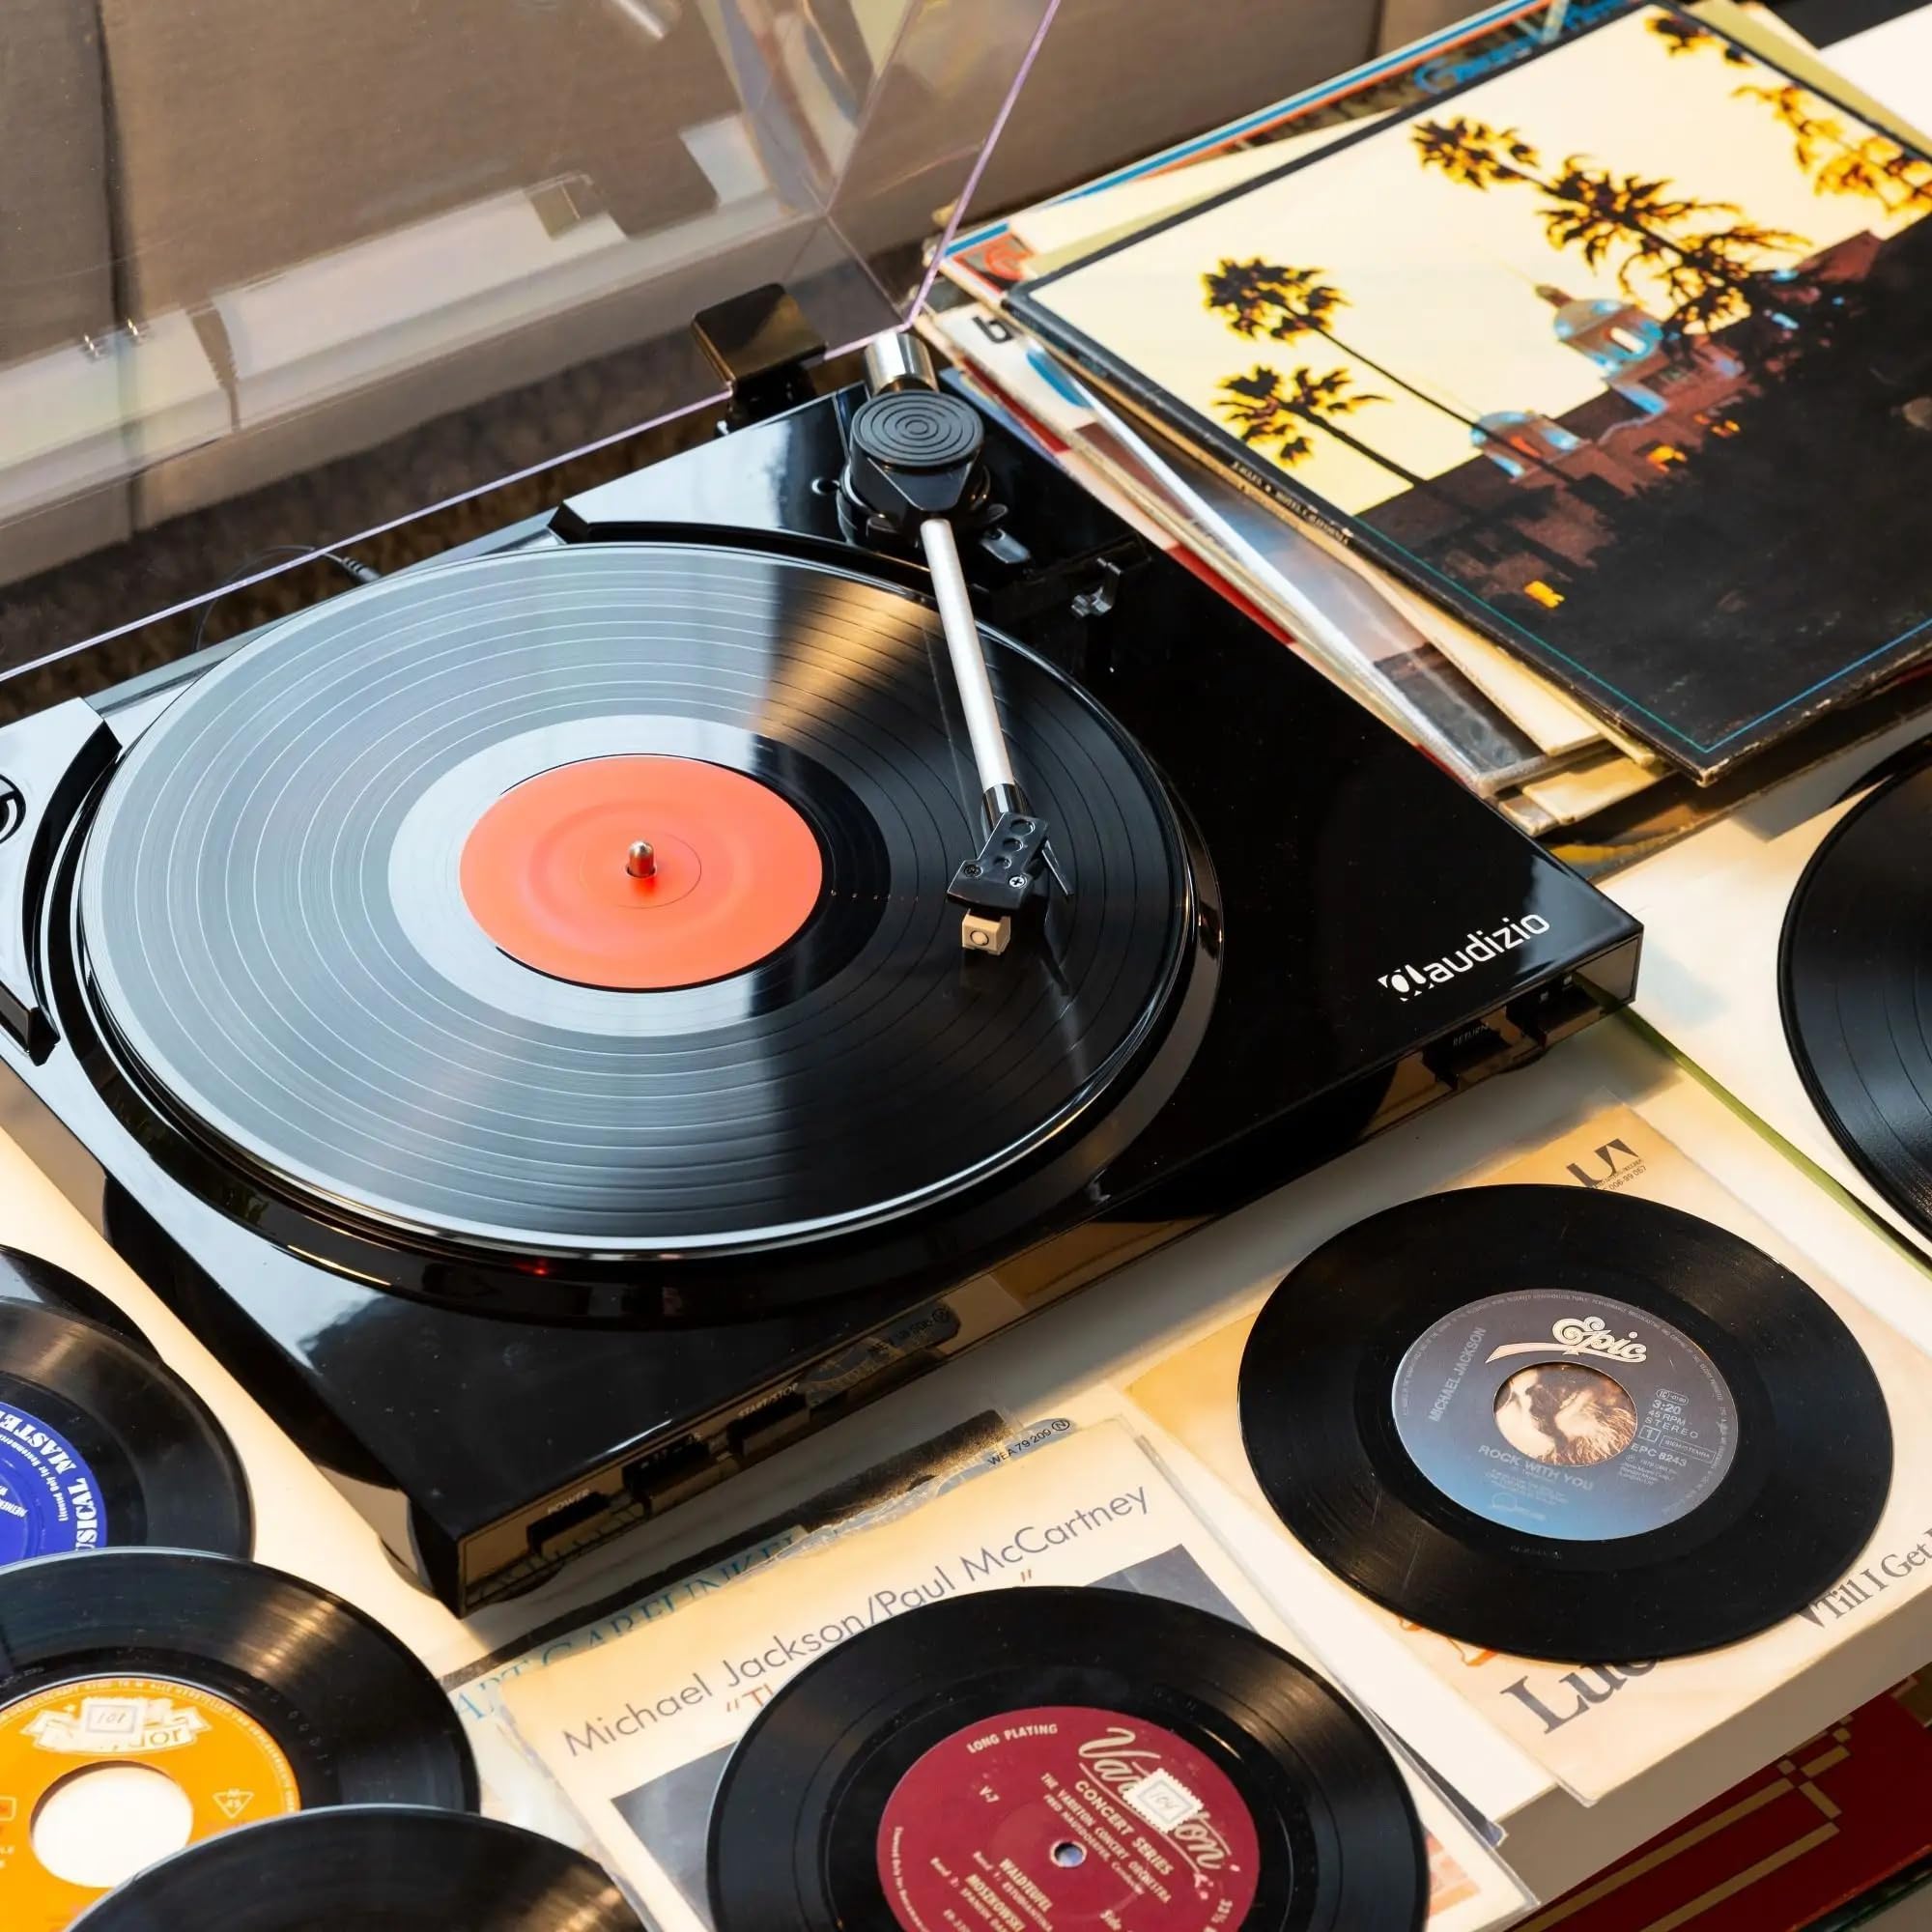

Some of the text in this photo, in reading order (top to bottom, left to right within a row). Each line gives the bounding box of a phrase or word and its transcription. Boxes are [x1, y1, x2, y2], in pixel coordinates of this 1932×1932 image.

[1422, 913, 1550, 984] audizio
[1549, 1316, 1647, 1363] Epic
[1428, 1378, 1461, 1423] MICHAEL
[1457, 1326, 1488, 1377] JACKSON
[1644, 1416, 1698, 1438] STEREO
[1648, 1409, 1686, 1427] 45 RPM
[1652, 1399, 1683, 1415] 3:20
[986, 1448, 1016, 1465] WEA
[1014, 1439, 1031, 1452] 79
[1030, 1429, 1051, 1443] 209
[1478, 1444, 1594, 1492] ROCK WITH YOU
[1630, 1442, 1688, 1467] EPC 8243
[547, 1489, 590, 1515] POWER
[1816, 1543, 1932, 1619] Till I Get
[562, 1486, 1150, 1757] Michael Jackson/Paul McCartney
[966, 1723, 1058, 1753] LONG PLAYING
[1040, 1772, 1060, 1790] THE
[1094, 1826, 1130, 1860] CONCERT
[1074, 1779, 1175, 1876] CONCERT SERIES
